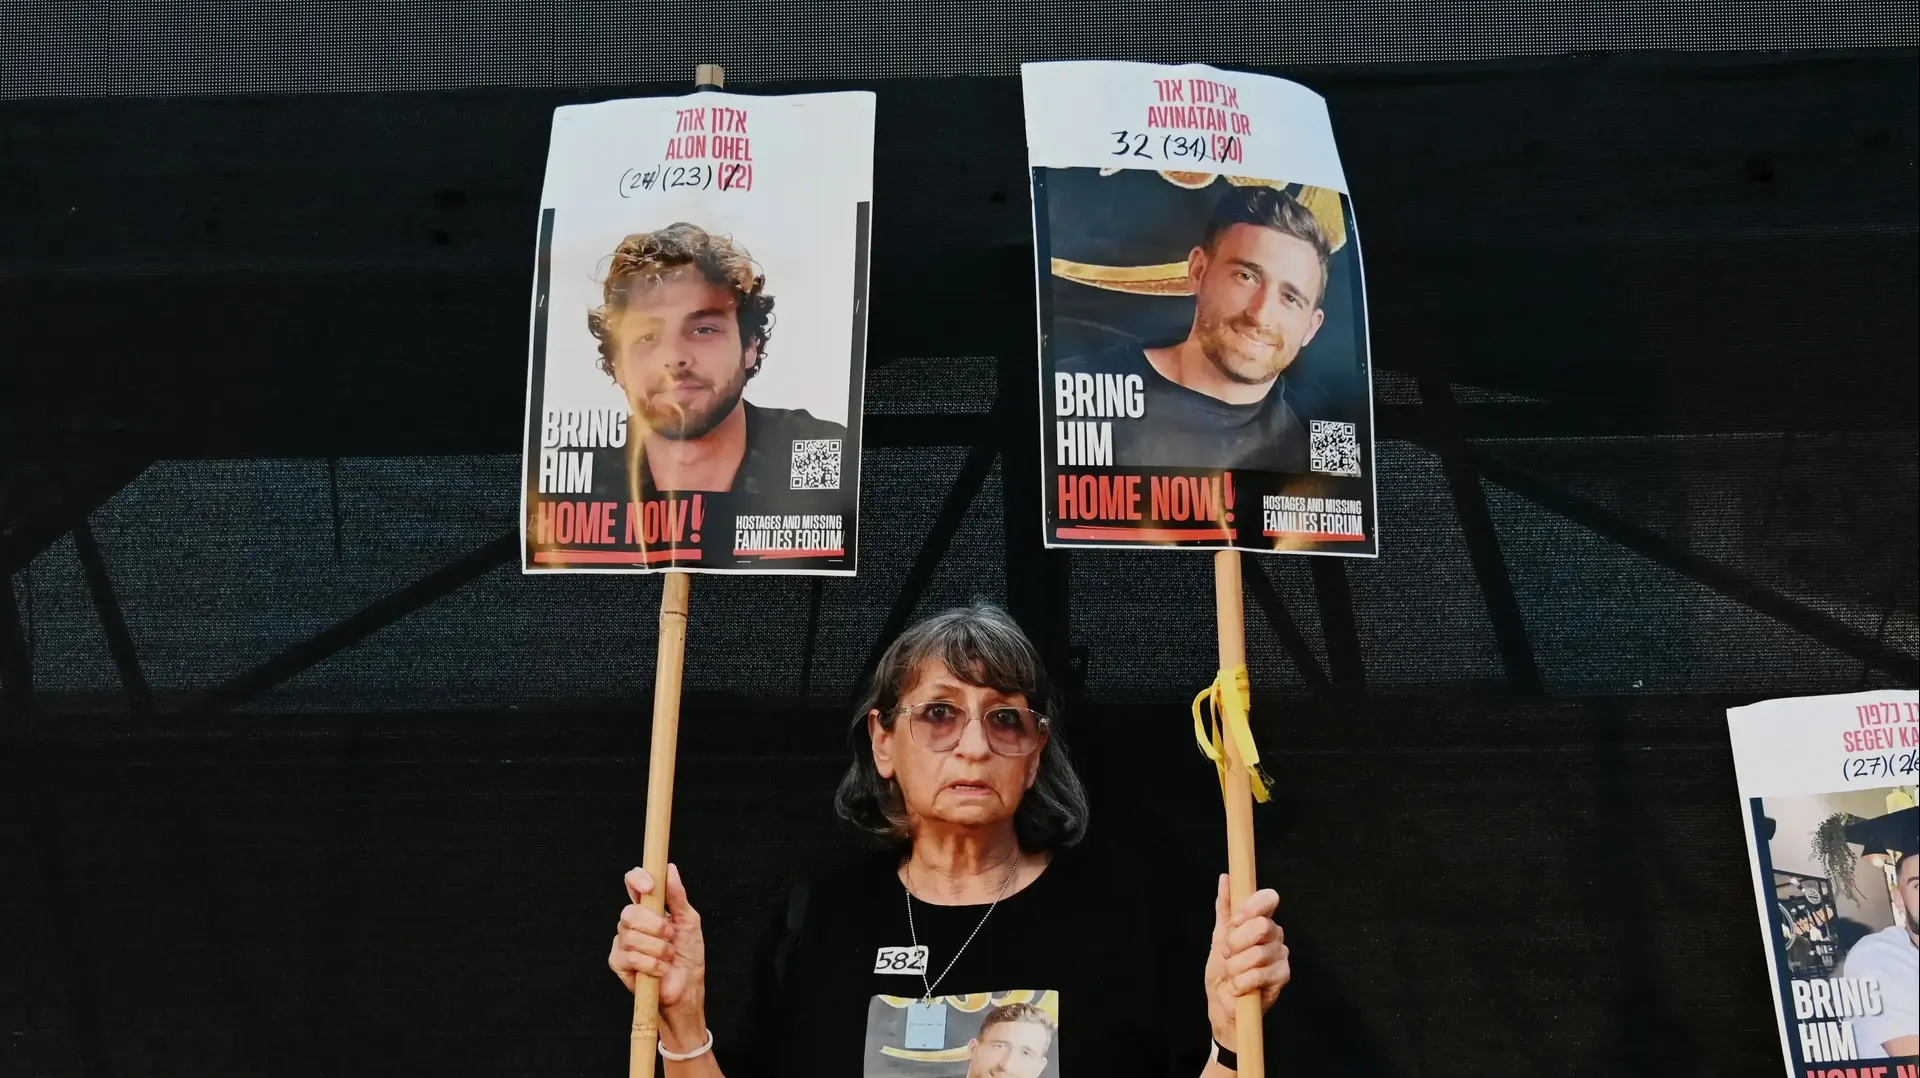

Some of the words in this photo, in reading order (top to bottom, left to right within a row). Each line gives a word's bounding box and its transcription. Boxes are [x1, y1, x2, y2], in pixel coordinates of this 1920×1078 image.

[1153, 79, 1184, 102] אור
[1188, 79, 1239, 109] אבינתן
[676, 107, 705, 133] אהל
[711, 107, 747, 133] אלון
[1147, 106, 1227, 132] AVINATAN
[1230, 112, 1251, 136] OR
[665, 135, 706, 160] ALON
[712, 135, 752, 161] OHEL
[1110, 130, 1153, 160] 32
[1163, 134, 1206, 162] (31)
[662, 165, 712, 191] (23)
[1055, 372, 1144, 419] BRING
[543, 408, 627, 449] BRING
[1057, 421, 1113, 466] HIM
[539, 451, 594, 494] HIM
[1058, 475, 1141, 521] HOME
[1151, 472, 1236, 522] NOW!
[1263, 495, 1306, 512] HOSTAGES
[1306, 498, 1324, 513] AND
[1325, 499, 1362, 515] MISSING
[537, 502, 617, 545] HOME
[625, 494, 702, 544] NOW!
[736, 515, 781, 530] HOSTAGES
[782, 515, 800, 530] AND
[801, 515, 842, 530] MISSING
[1263, 511, 1319, 533] FAMILIES
[1320, 513, 1362, 535] FORUM
[735, 530, 792, 550] FAMILIES
[794, 530, 843, 550] FORUM
[1856, 702, 1901, 728] כלפון
[1843, 727, 1893, 752] SEGEV
[1843, 755, 1888, 781] (27)
[876, 950, 926, 970] 582
[1791, 977, 1882, 1019] BRING
[1798, 1021, 1858, 1063] HIM
